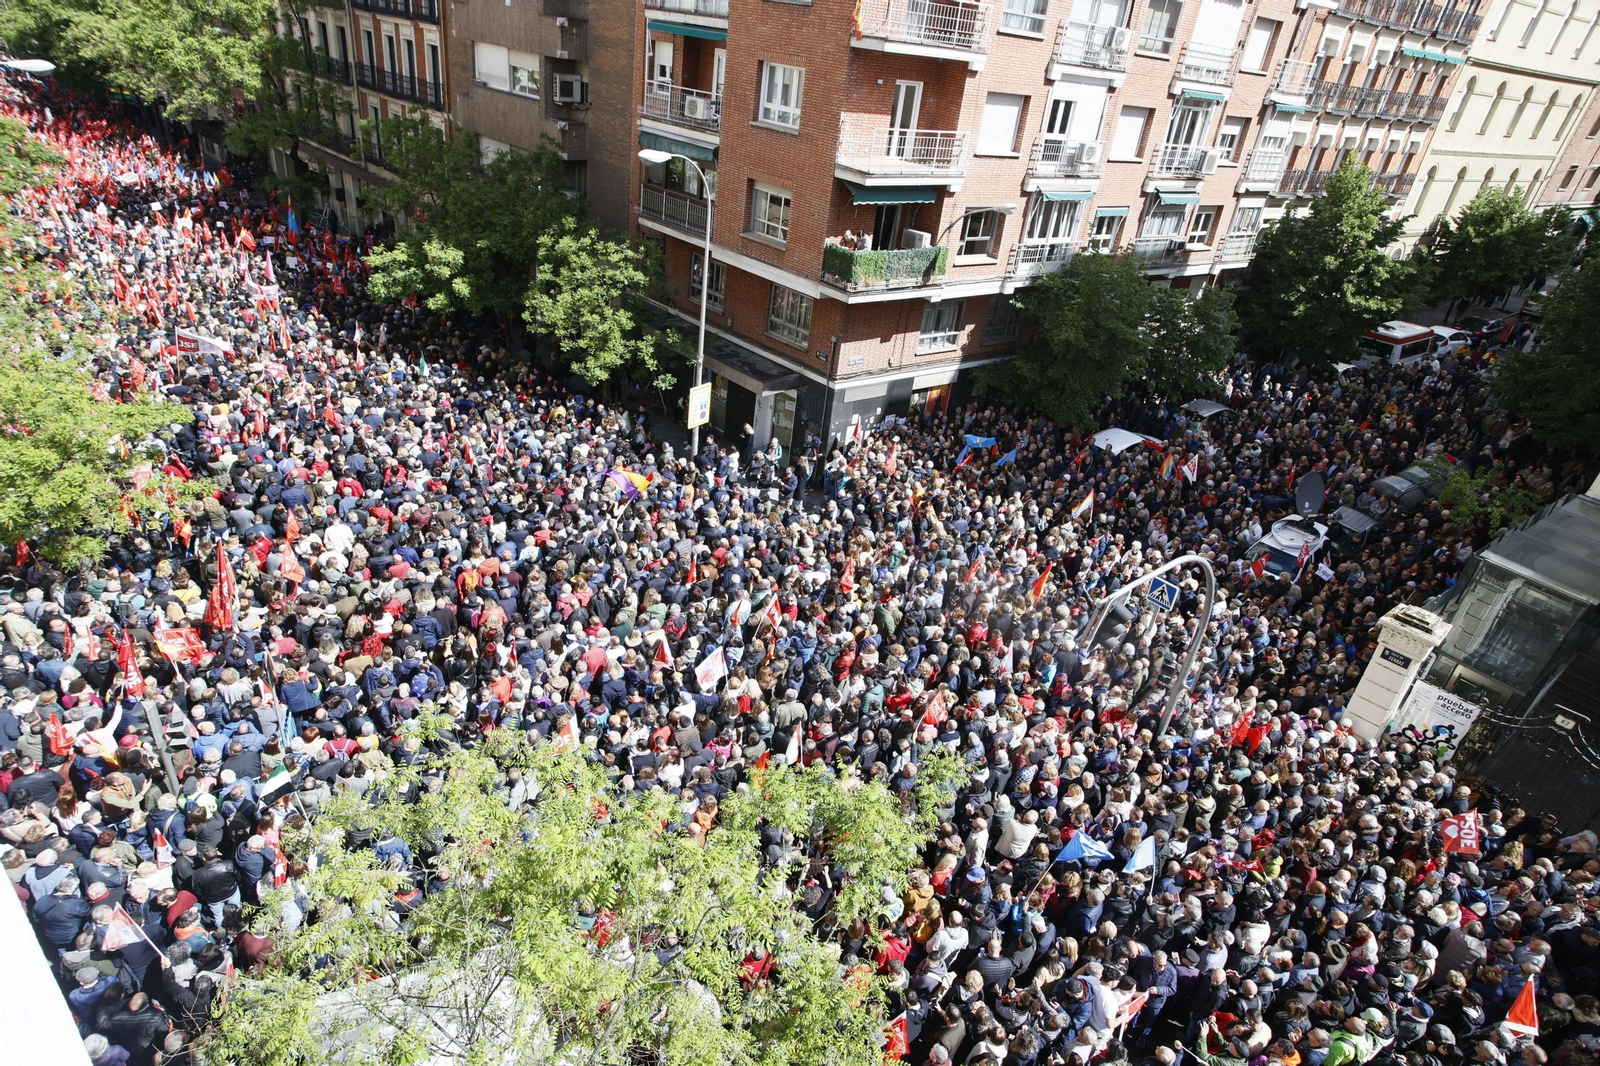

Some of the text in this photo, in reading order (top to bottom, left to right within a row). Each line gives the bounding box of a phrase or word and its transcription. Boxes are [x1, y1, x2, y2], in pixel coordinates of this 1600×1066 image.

[178, 339, 198, 349] JSE
[1388, 656, 1405, 666] FERRAZ
[1436, 694, 1474, 714] pruebas
[1440, 703, 1471, 719] acceso
[1460, 810, 1477, 849] PSOE
